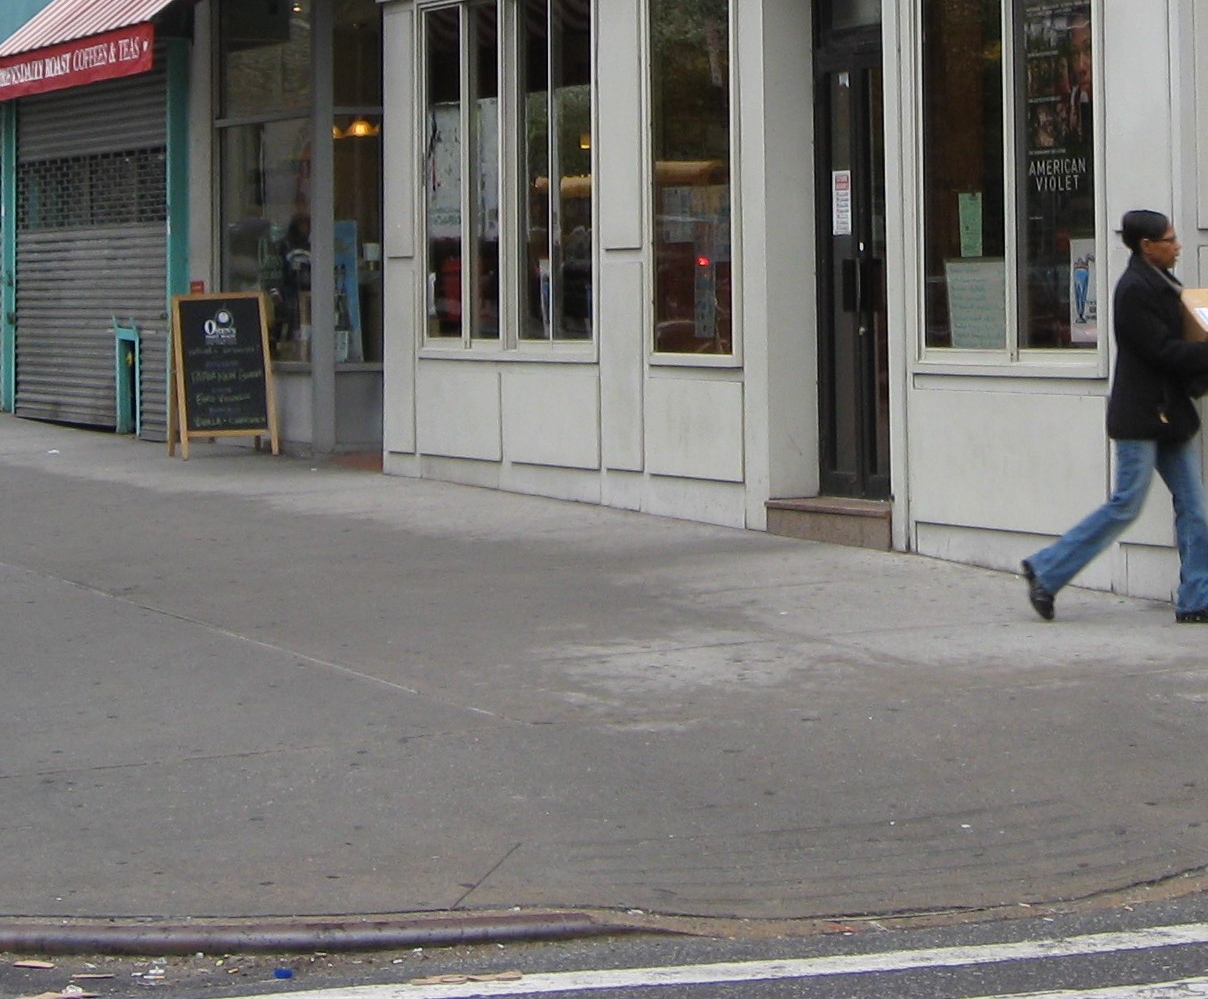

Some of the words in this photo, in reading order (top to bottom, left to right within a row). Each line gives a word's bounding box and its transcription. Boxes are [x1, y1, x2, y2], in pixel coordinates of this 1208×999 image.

[73, 43, 108, 71] COFFEES
[108, 41, 117, 64] &
[118, 36, 140, 62] TEAS
[1029, 157, 1086, 176] AMERICAN
[1036, 174, 1079, 191] VIOLET
